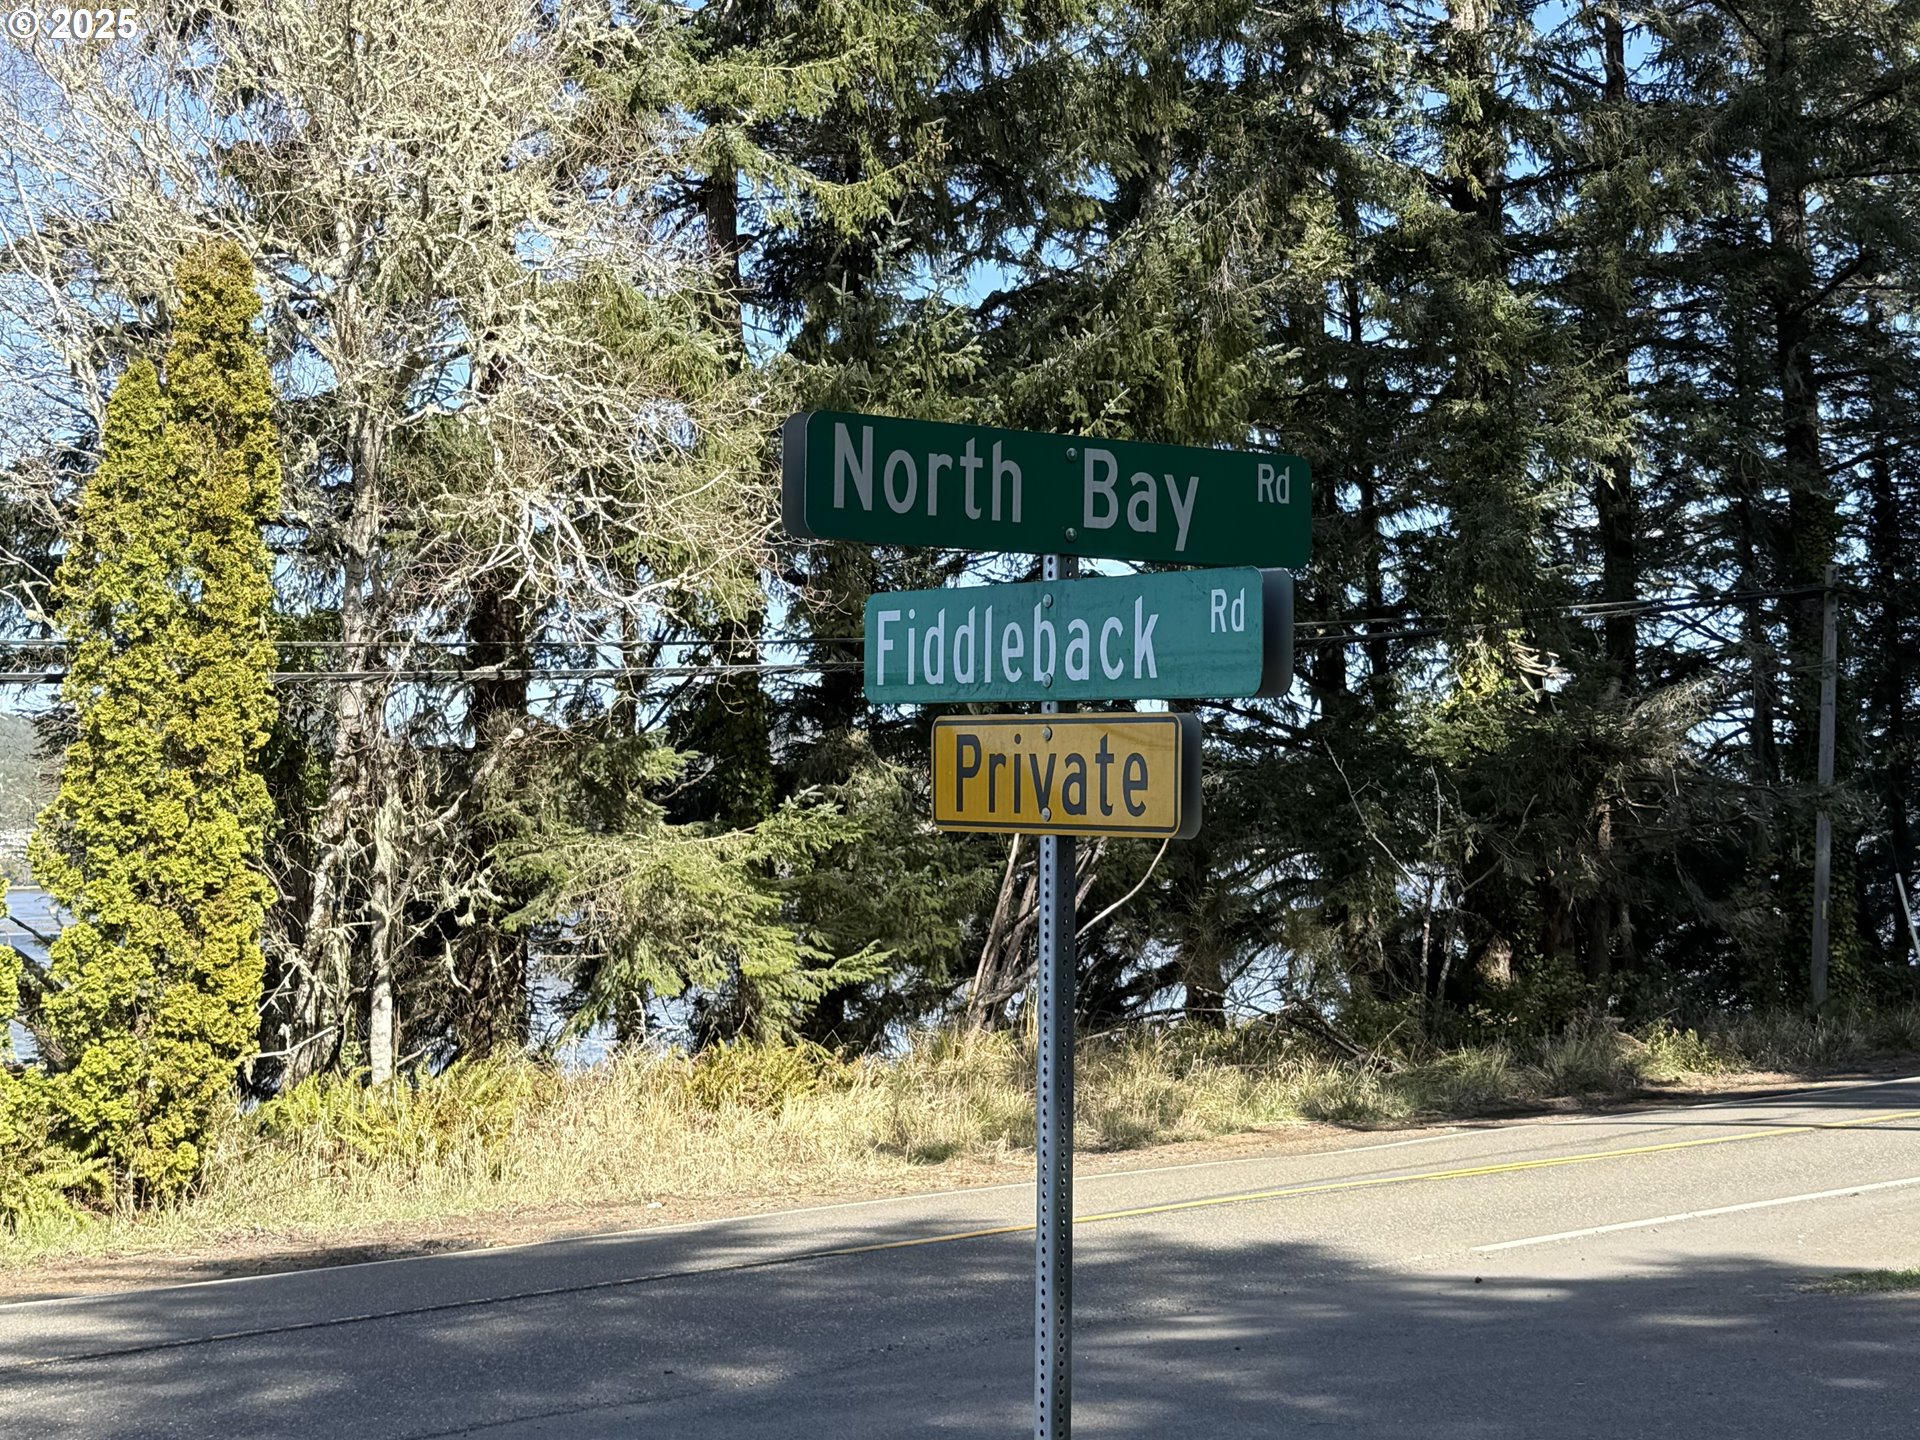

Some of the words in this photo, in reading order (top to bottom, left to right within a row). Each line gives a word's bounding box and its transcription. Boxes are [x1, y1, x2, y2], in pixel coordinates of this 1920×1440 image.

[833, 422, 1022, 523] North
[1083, 448, 1199, 552] Bay
[1257, 463, 1290, 504] Rd
[876, 595, 1159, 686] Fiddleback
[1210, 588, 1246, 633] Rd
[955, 732, 1149, 817] Private
